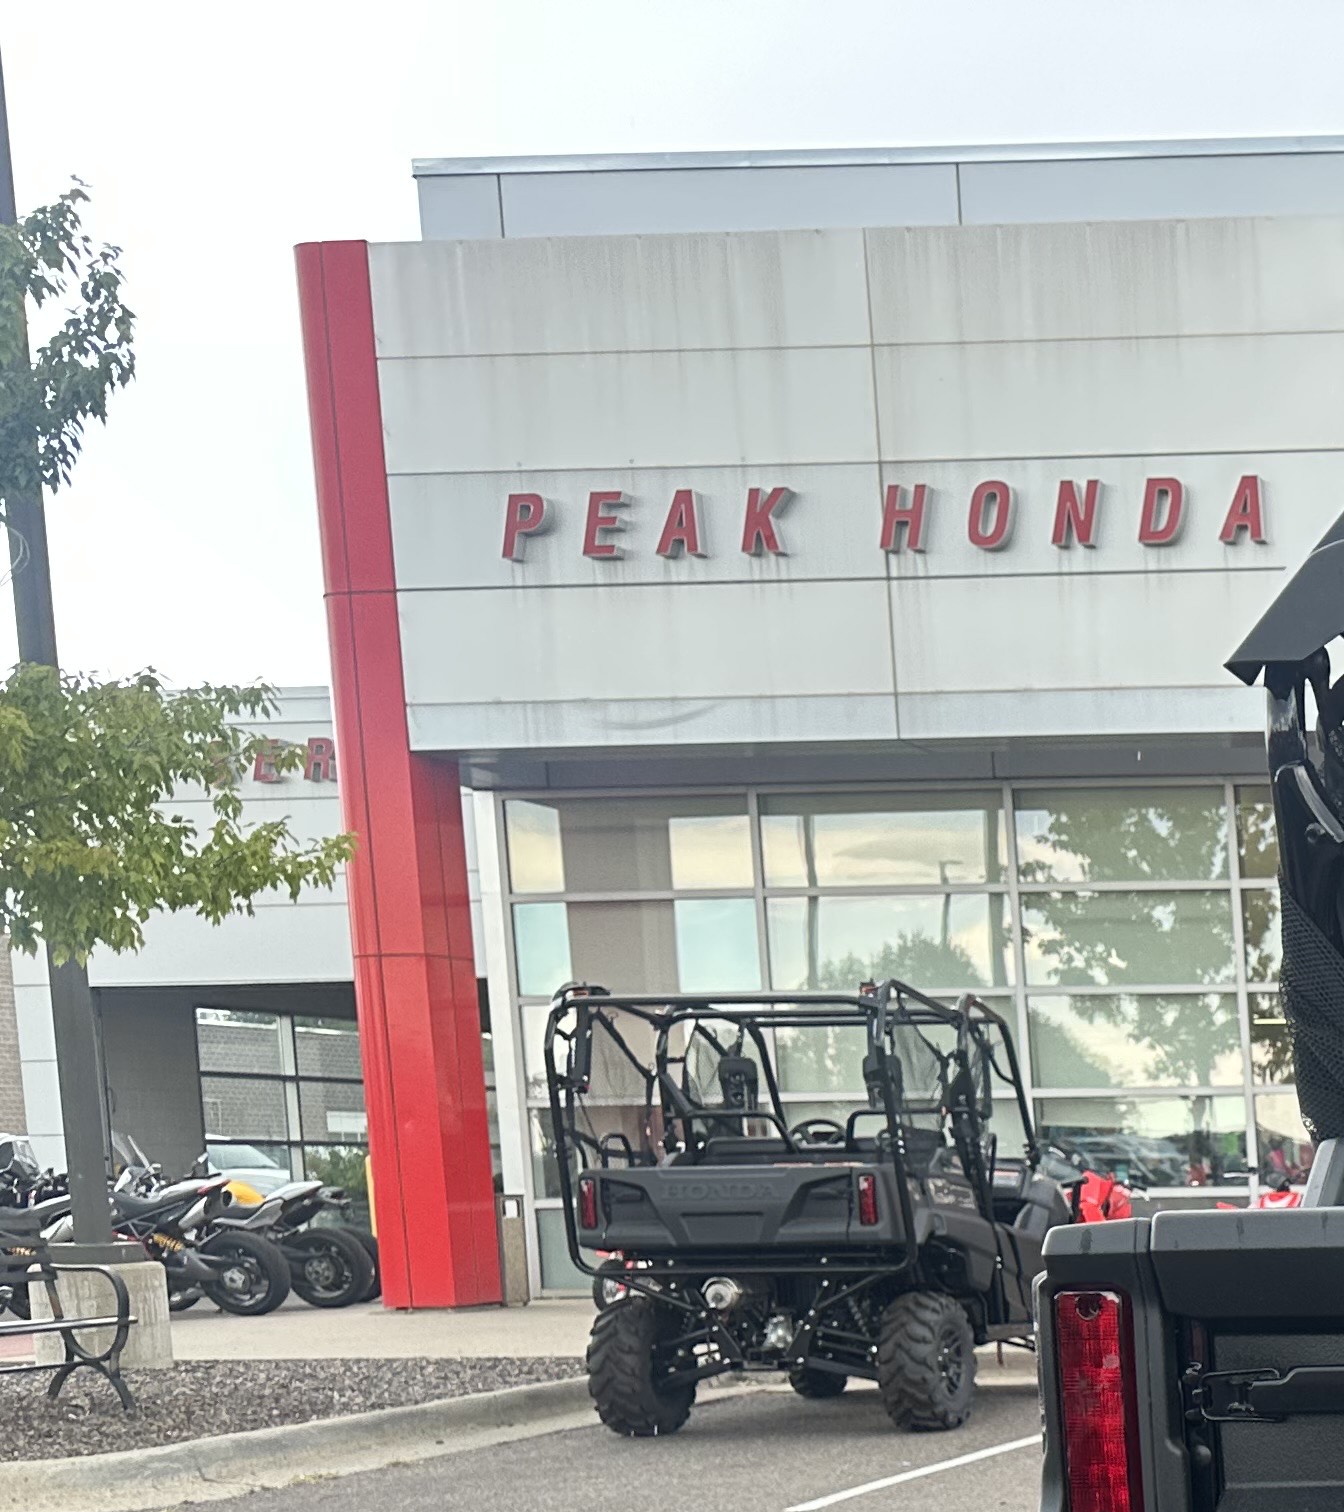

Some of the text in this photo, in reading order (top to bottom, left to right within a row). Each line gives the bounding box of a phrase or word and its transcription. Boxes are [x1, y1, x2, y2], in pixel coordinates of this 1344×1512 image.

[501, 474, 1268, 561] PEAK HONDA
[661, 1182, 781, 1201] HONDA
